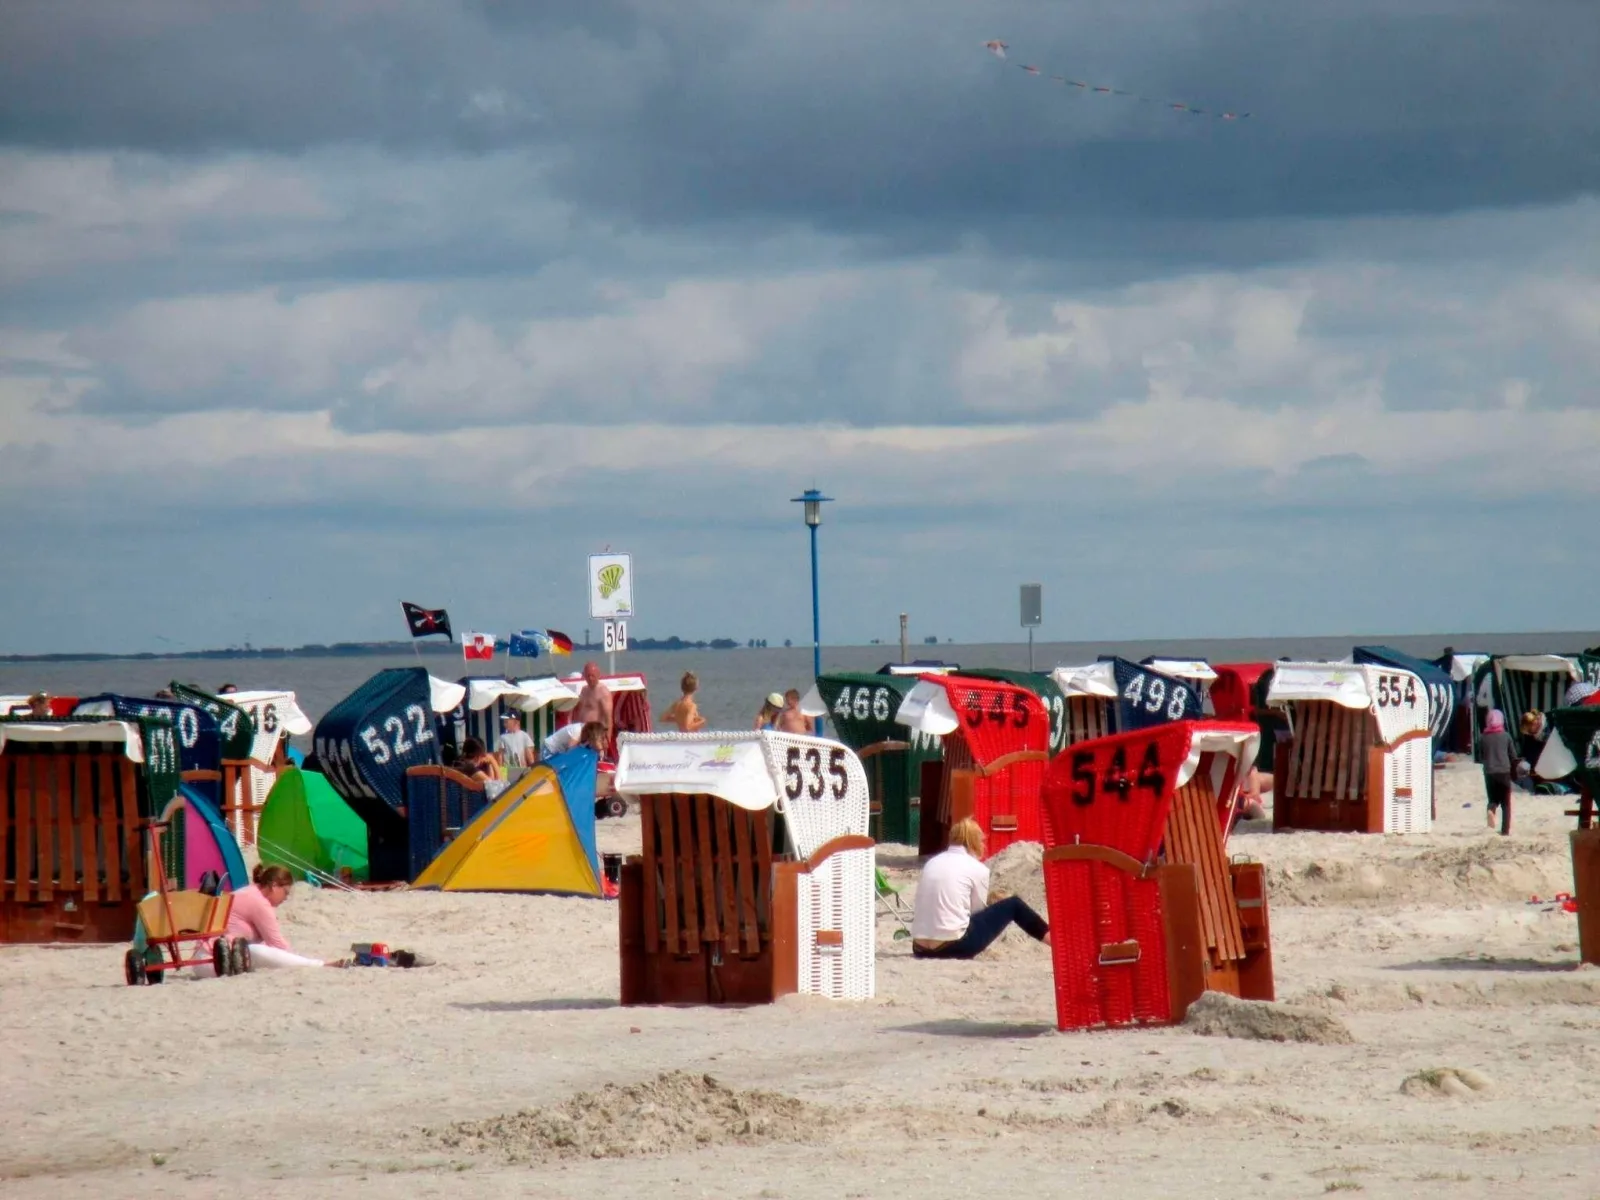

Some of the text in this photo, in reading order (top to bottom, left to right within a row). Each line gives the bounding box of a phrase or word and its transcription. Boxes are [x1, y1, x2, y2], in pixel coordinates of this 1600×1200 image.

[834, 686, 890, 721] 466
[965, 691, 1030, 728] 545
[1124, 672, 1189, 721] 498
[1377, 675, 1417, 710] 554
[359, 704, 434, 764] 522
[784, 746, 849, 801] 535
[1070, 742, 1165, 806] 544
